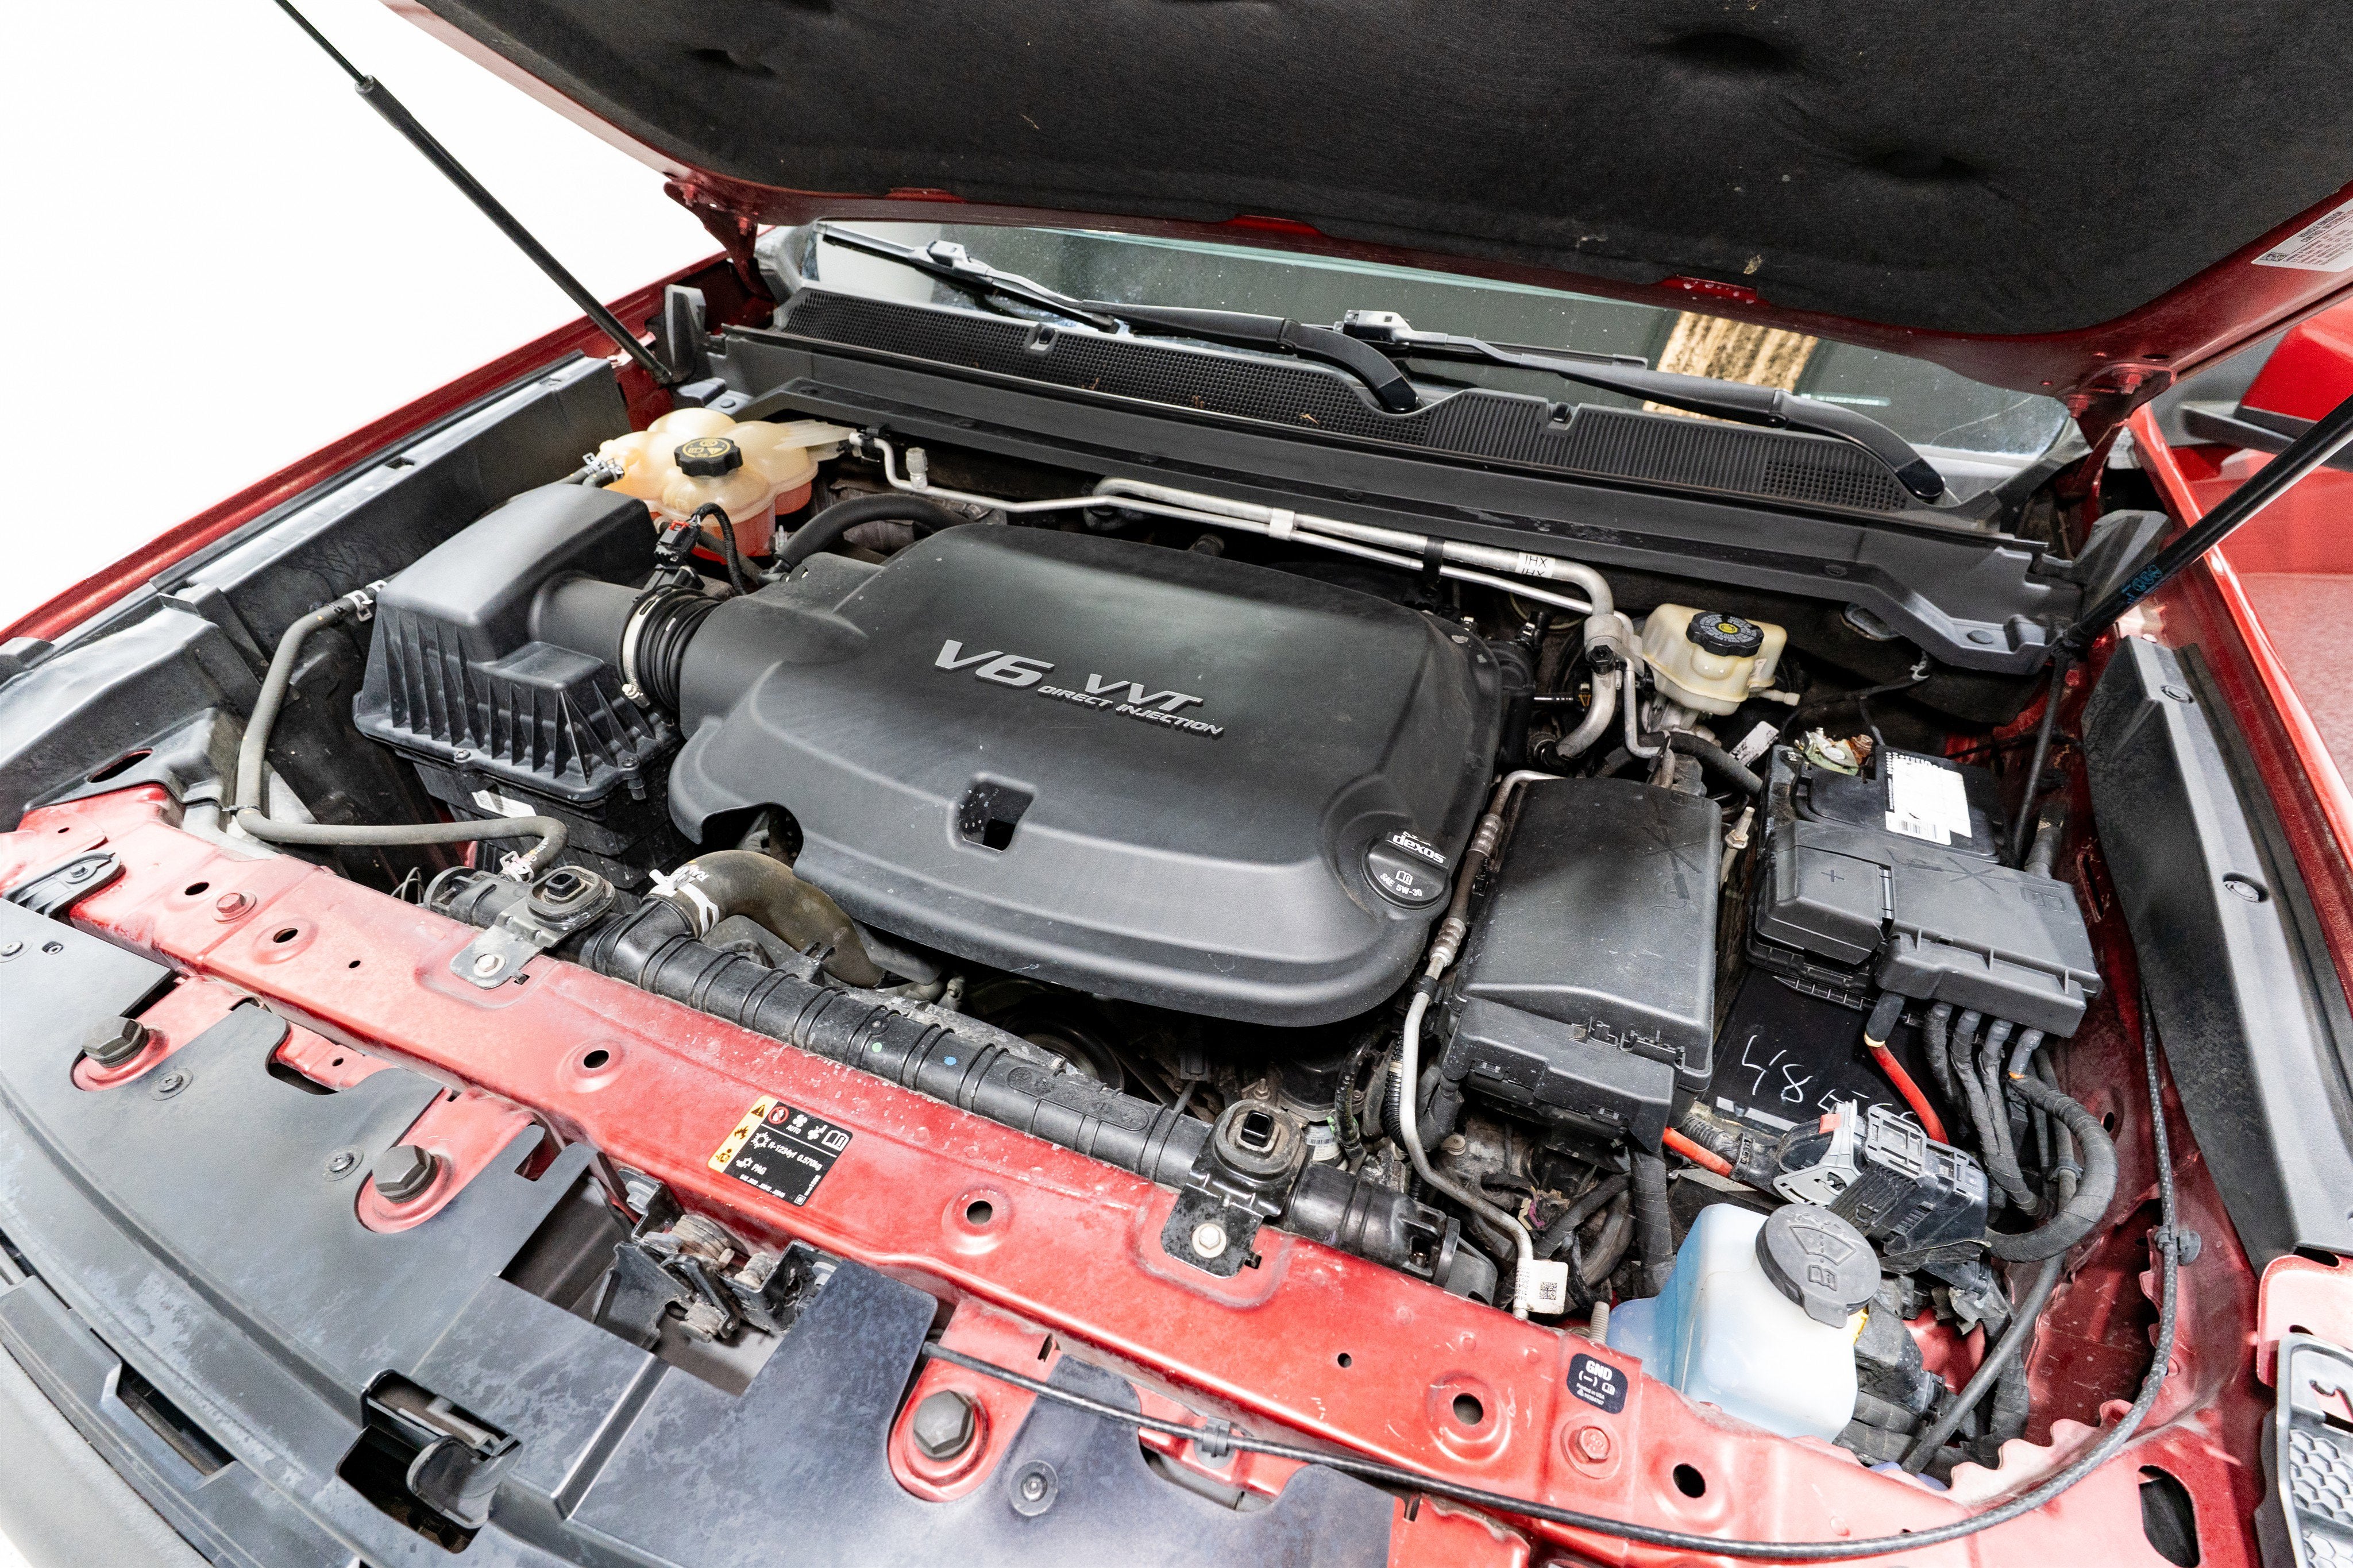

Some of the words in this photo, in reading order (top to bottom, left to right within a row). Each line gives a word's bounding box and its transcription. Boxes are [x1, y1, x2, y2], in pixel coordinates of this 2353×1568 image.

[1525, 555, 1548, 568] IHX
[934, 639, 1055, 688] V6
[1085, 673, 1204, 713] VVT
[1037, 685, 1114, 708] DIRECT
[1116, 704, 1224, 736] INJECTION
[1392, 835, 1446, 864] dexos
[1380, 873, 1395, 887] SAE
[1395, 883, 1423, 897] 5W-30
[786, 1124, 802, 1134] AUTO
[751, 1163, 767, 1175] PAG
[1586, 1360, 1613, 1381] GND
